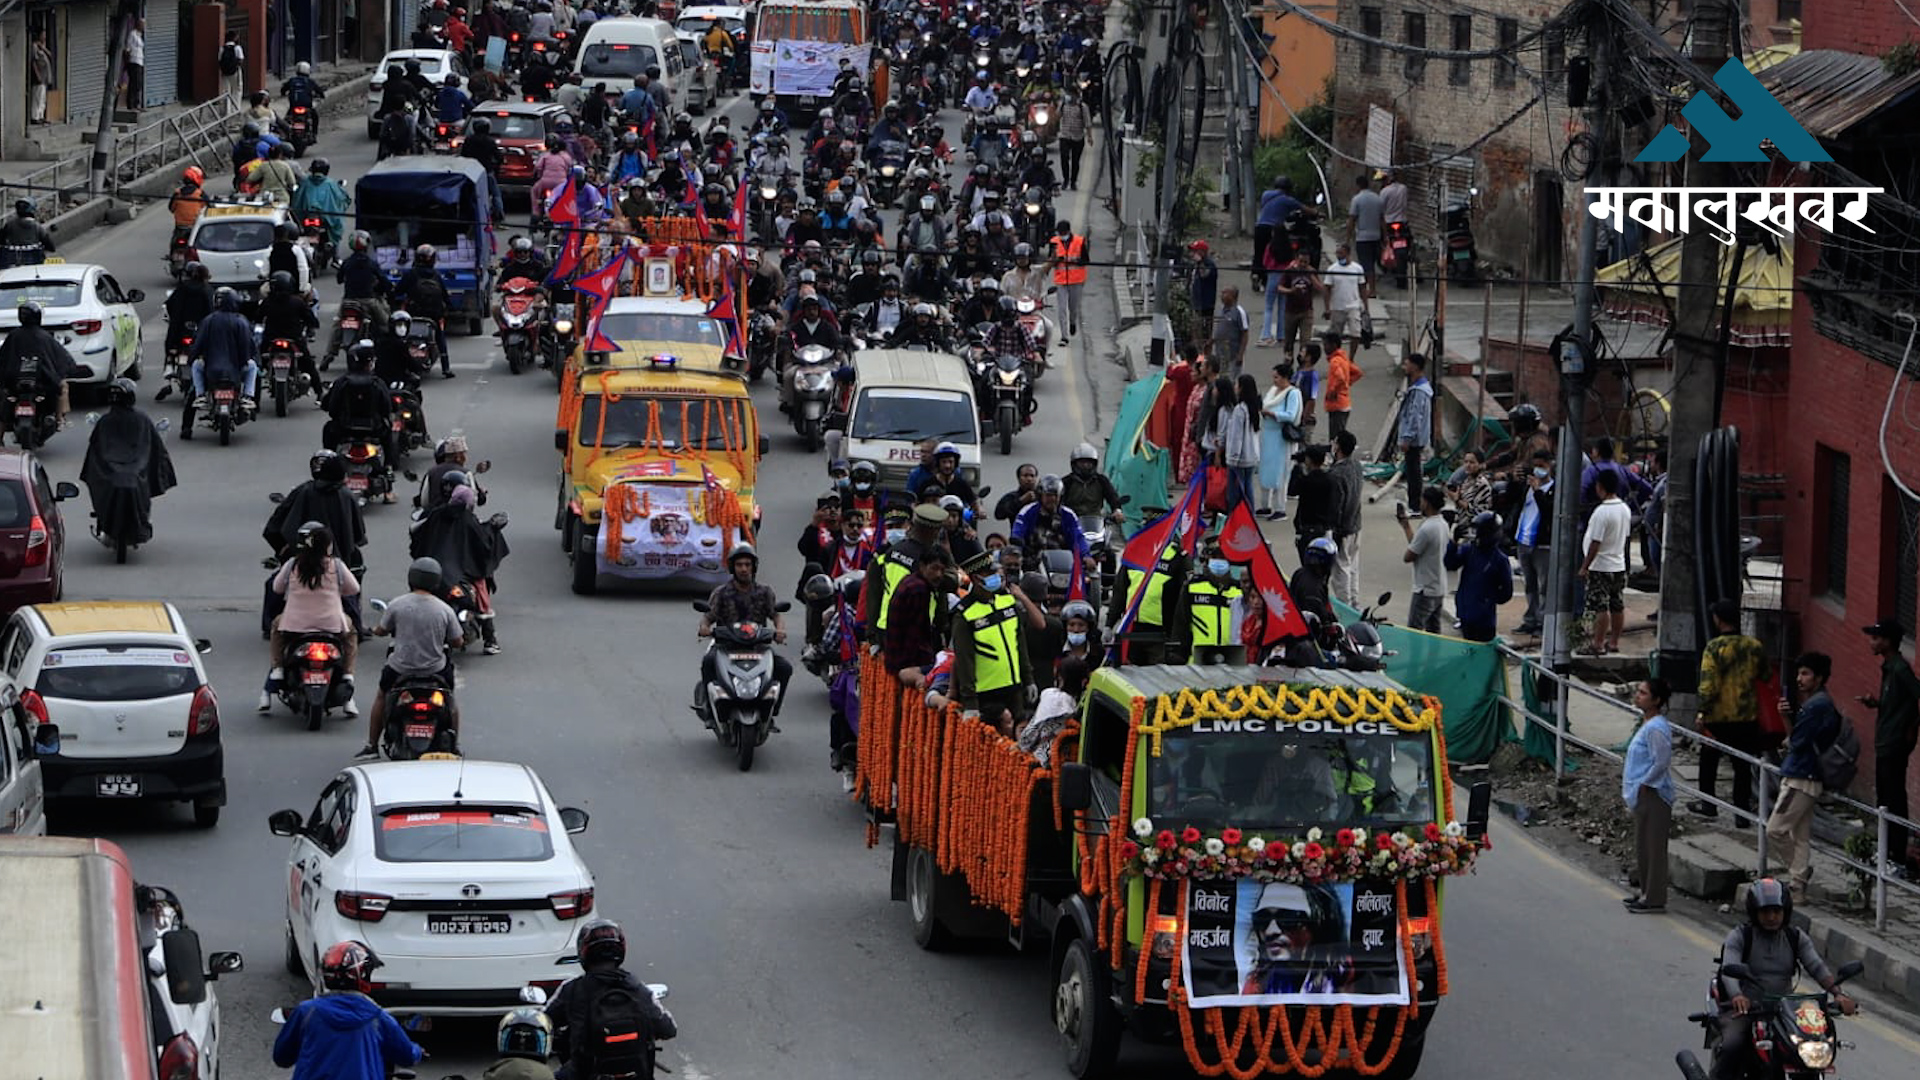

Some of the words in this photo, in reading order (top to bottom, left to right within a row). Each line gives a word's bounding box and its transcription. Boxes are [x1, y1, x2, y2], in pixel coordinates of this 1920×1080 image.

[889, 448, 921, 460] PRE
[1192, 719, 1267, 733] LMC
[1275, 719, 1399, 736] POLICE
[1194, 889, 1231, 912] विनोद
[1356, 889, 1393, 916] ललितपुर
[1190, 925, 1231, 947] महर्जन
[1362, 928, 1385, 952] दुपाट
